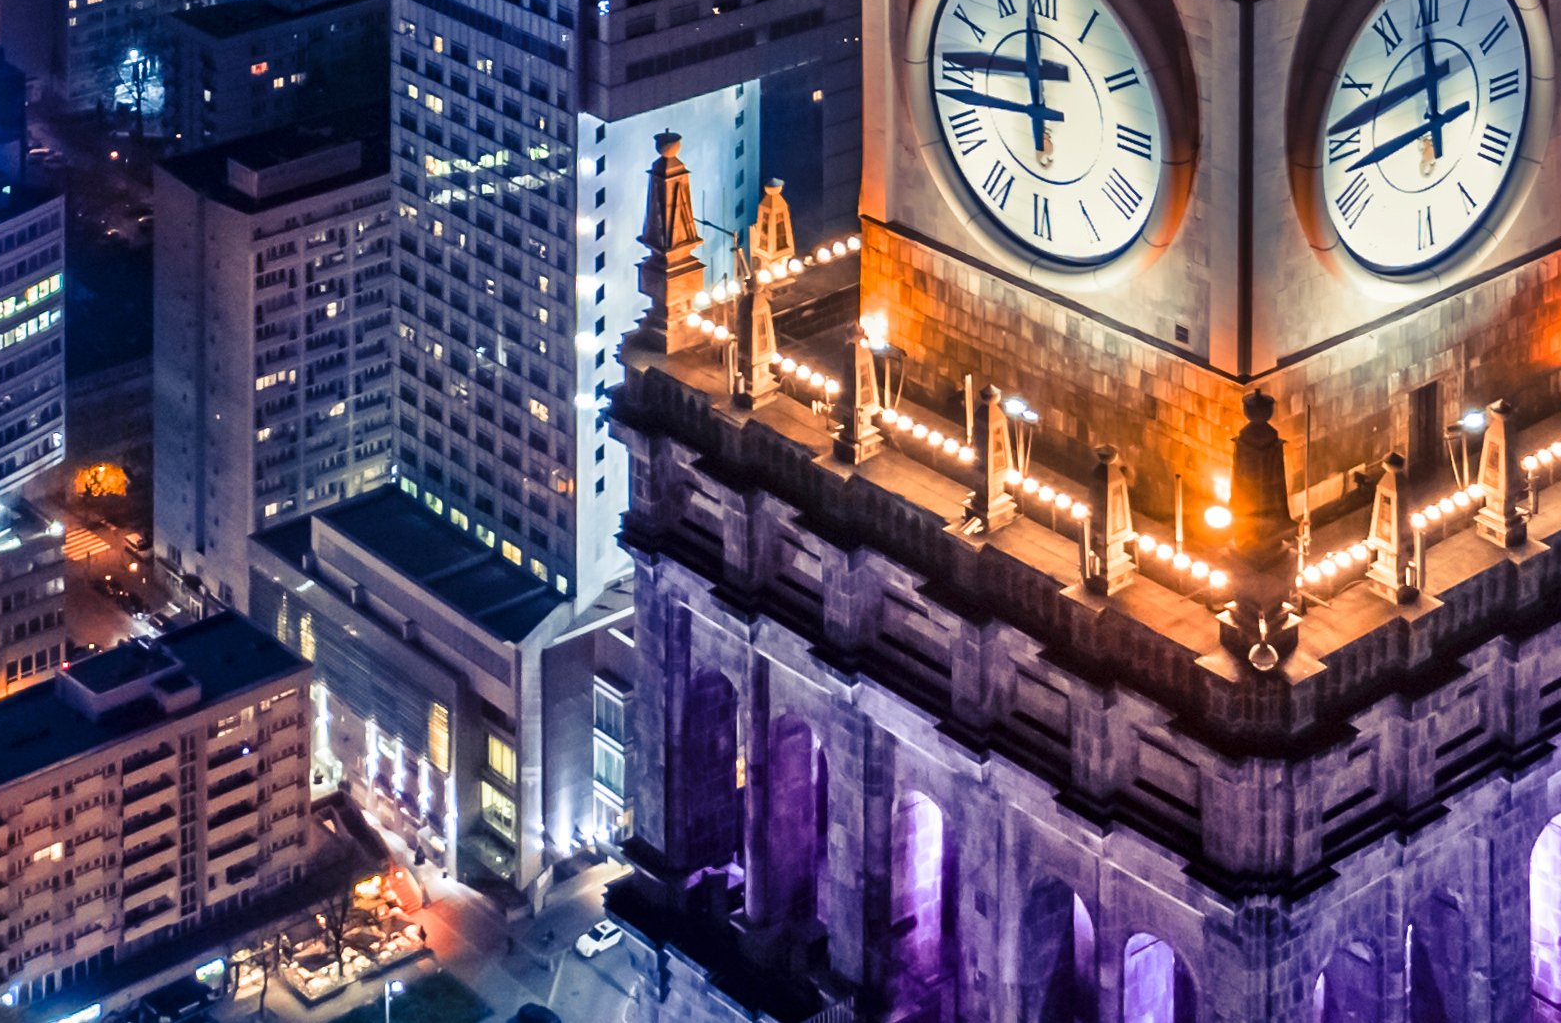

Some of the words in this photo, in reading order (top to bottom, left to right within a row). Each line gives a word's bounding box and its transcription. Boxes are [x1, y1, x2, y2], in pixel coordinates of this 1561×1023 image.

[953, 4, 986, 43] X
[1078, 9, 1100, 43] I
[1372, 9, 1403, 57] XI
[1479, 15, 1510, 56] II
[1104, 67, 1140, 93] II
[1340, 72, 1373, 98] X
[1489, 69, 1519, 104] III
[948, 109, 987, 156] VIII
[1116, 123, 1152, 161] III
[1329, 128, 1361, 164] IX
[982, 160, 1015, 210] VII
[1335, 171, 1374, 230] VIII
[1033, 193, 1052, 242] VI
